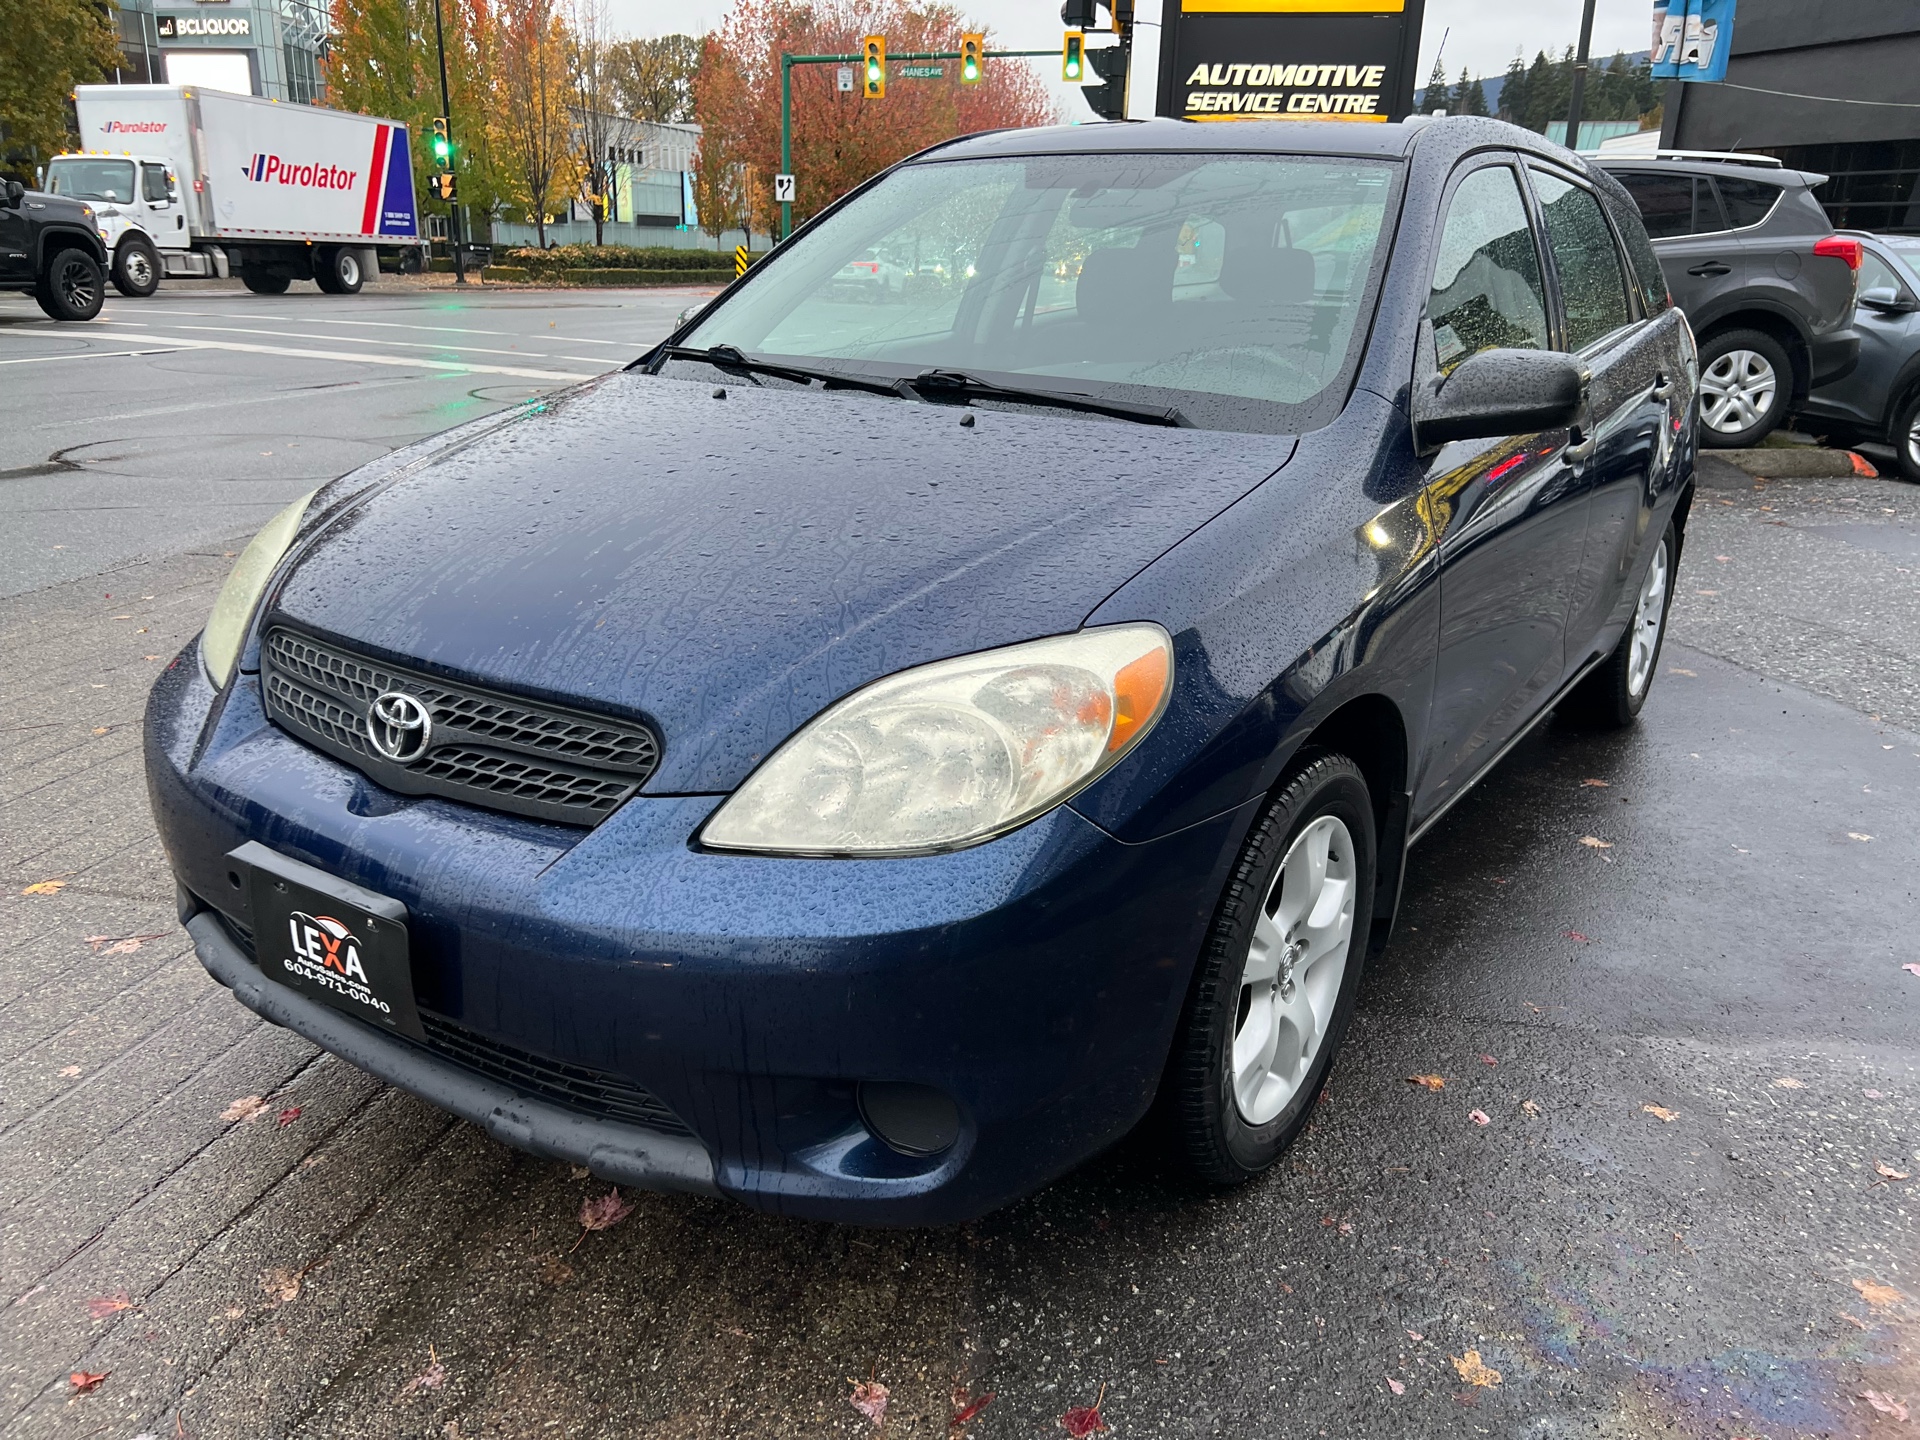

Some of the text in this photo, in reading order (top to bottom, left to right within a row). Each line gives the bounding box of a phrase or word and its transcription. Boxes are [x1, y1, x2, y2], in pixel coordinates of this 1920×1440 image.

[177, 19, 249, 34] BCLIQUOR
[1185, 63, 1386, 87] AUTOMOTIVE
[1185, 92, 1380, 113] SERVICE CENTRE
[112, 121, 167, 133] Purolator
[265, 155, 357, 191] Purolator
[289, 919, 369, 984] LEXA
[283, 959, 391, 1014] 604-971-0040
[297, 956, 372, 995] AutoSales.com
